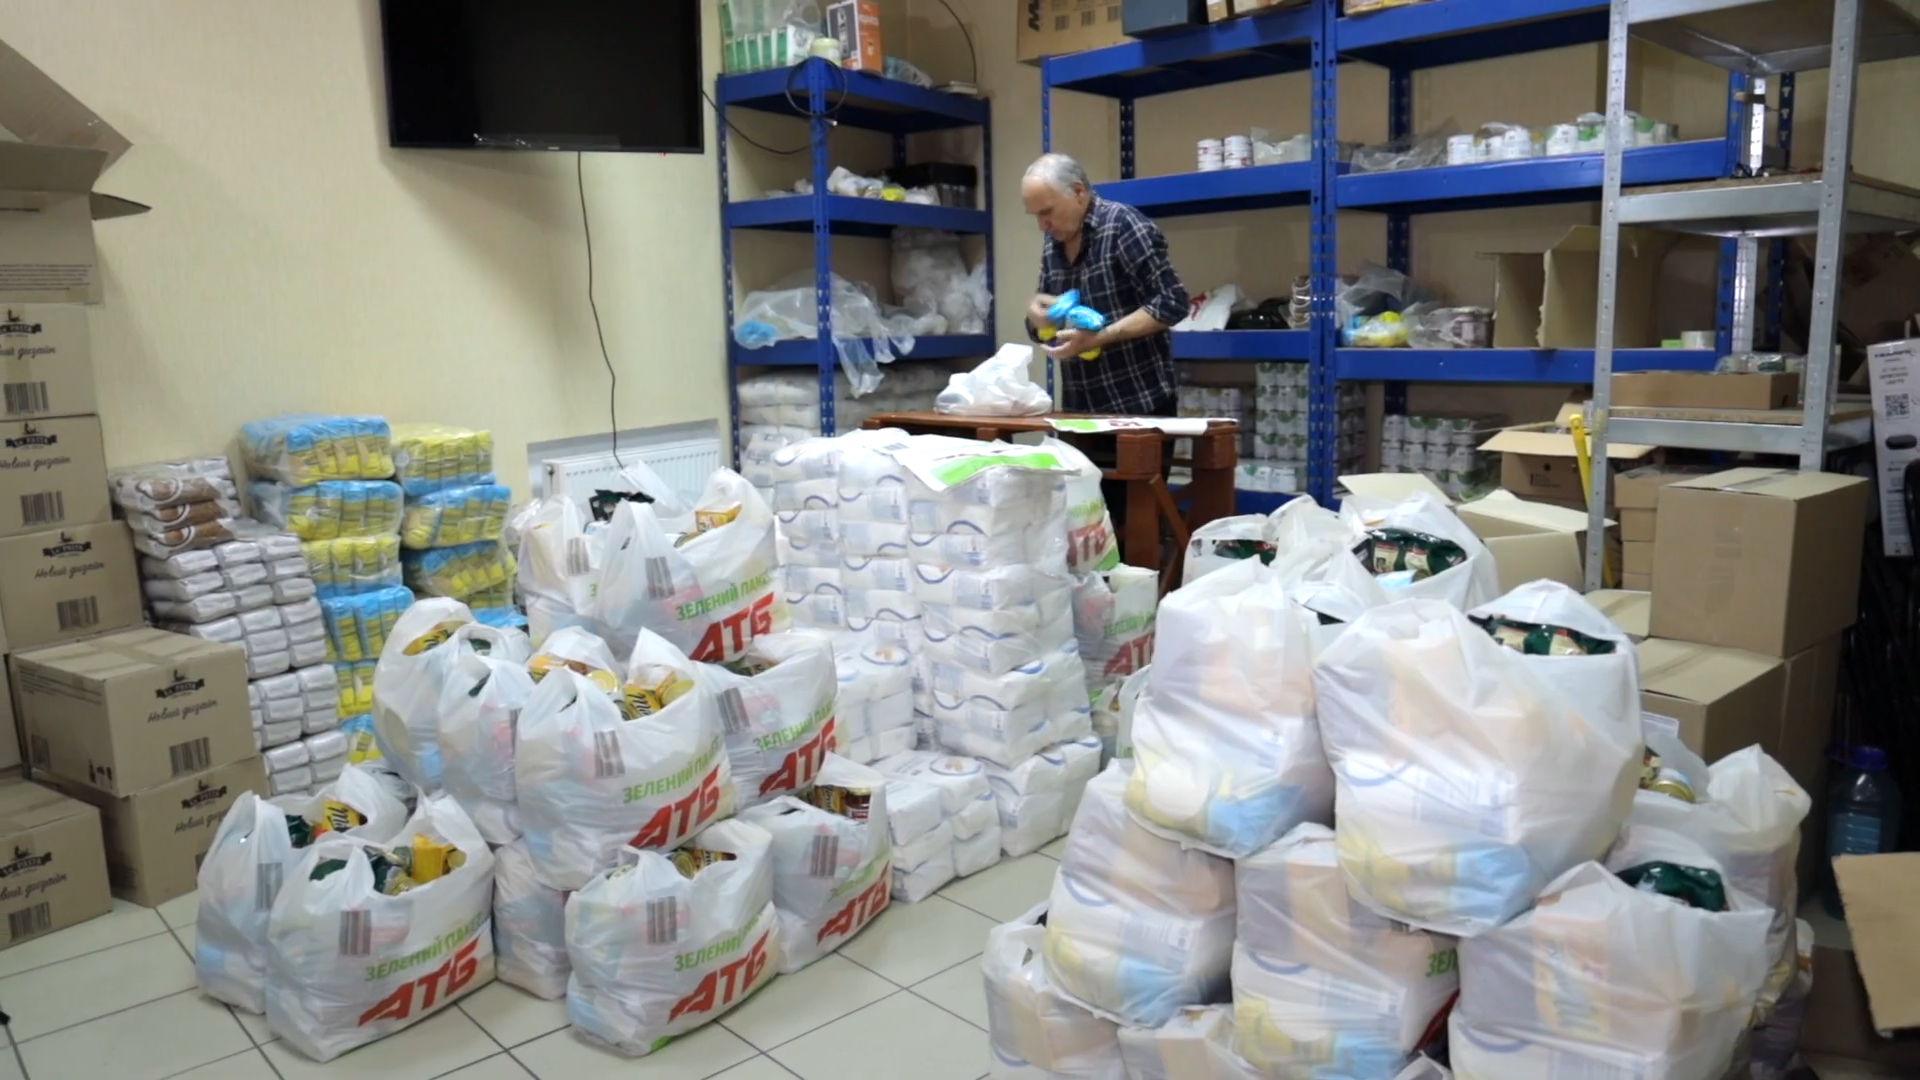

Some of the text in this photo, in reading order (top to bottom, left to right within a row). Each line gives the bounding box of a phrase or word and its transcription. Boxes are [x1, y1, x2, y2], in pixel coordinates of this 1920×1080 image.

[675, 580, 739, 621] ЗЕЛЕНИЙ
[688, 591, 776, 663] АТБ
[622, 759, 695, 804] ЗЕЛЕНИЙ
[628, 763, 721, 848] АТБ
[356, 934, 481, 1028] АТБ
[364, 934, 444, 982] ЗЕЛЕНИЙ
[666, 928, 770, 1026] АТБ
